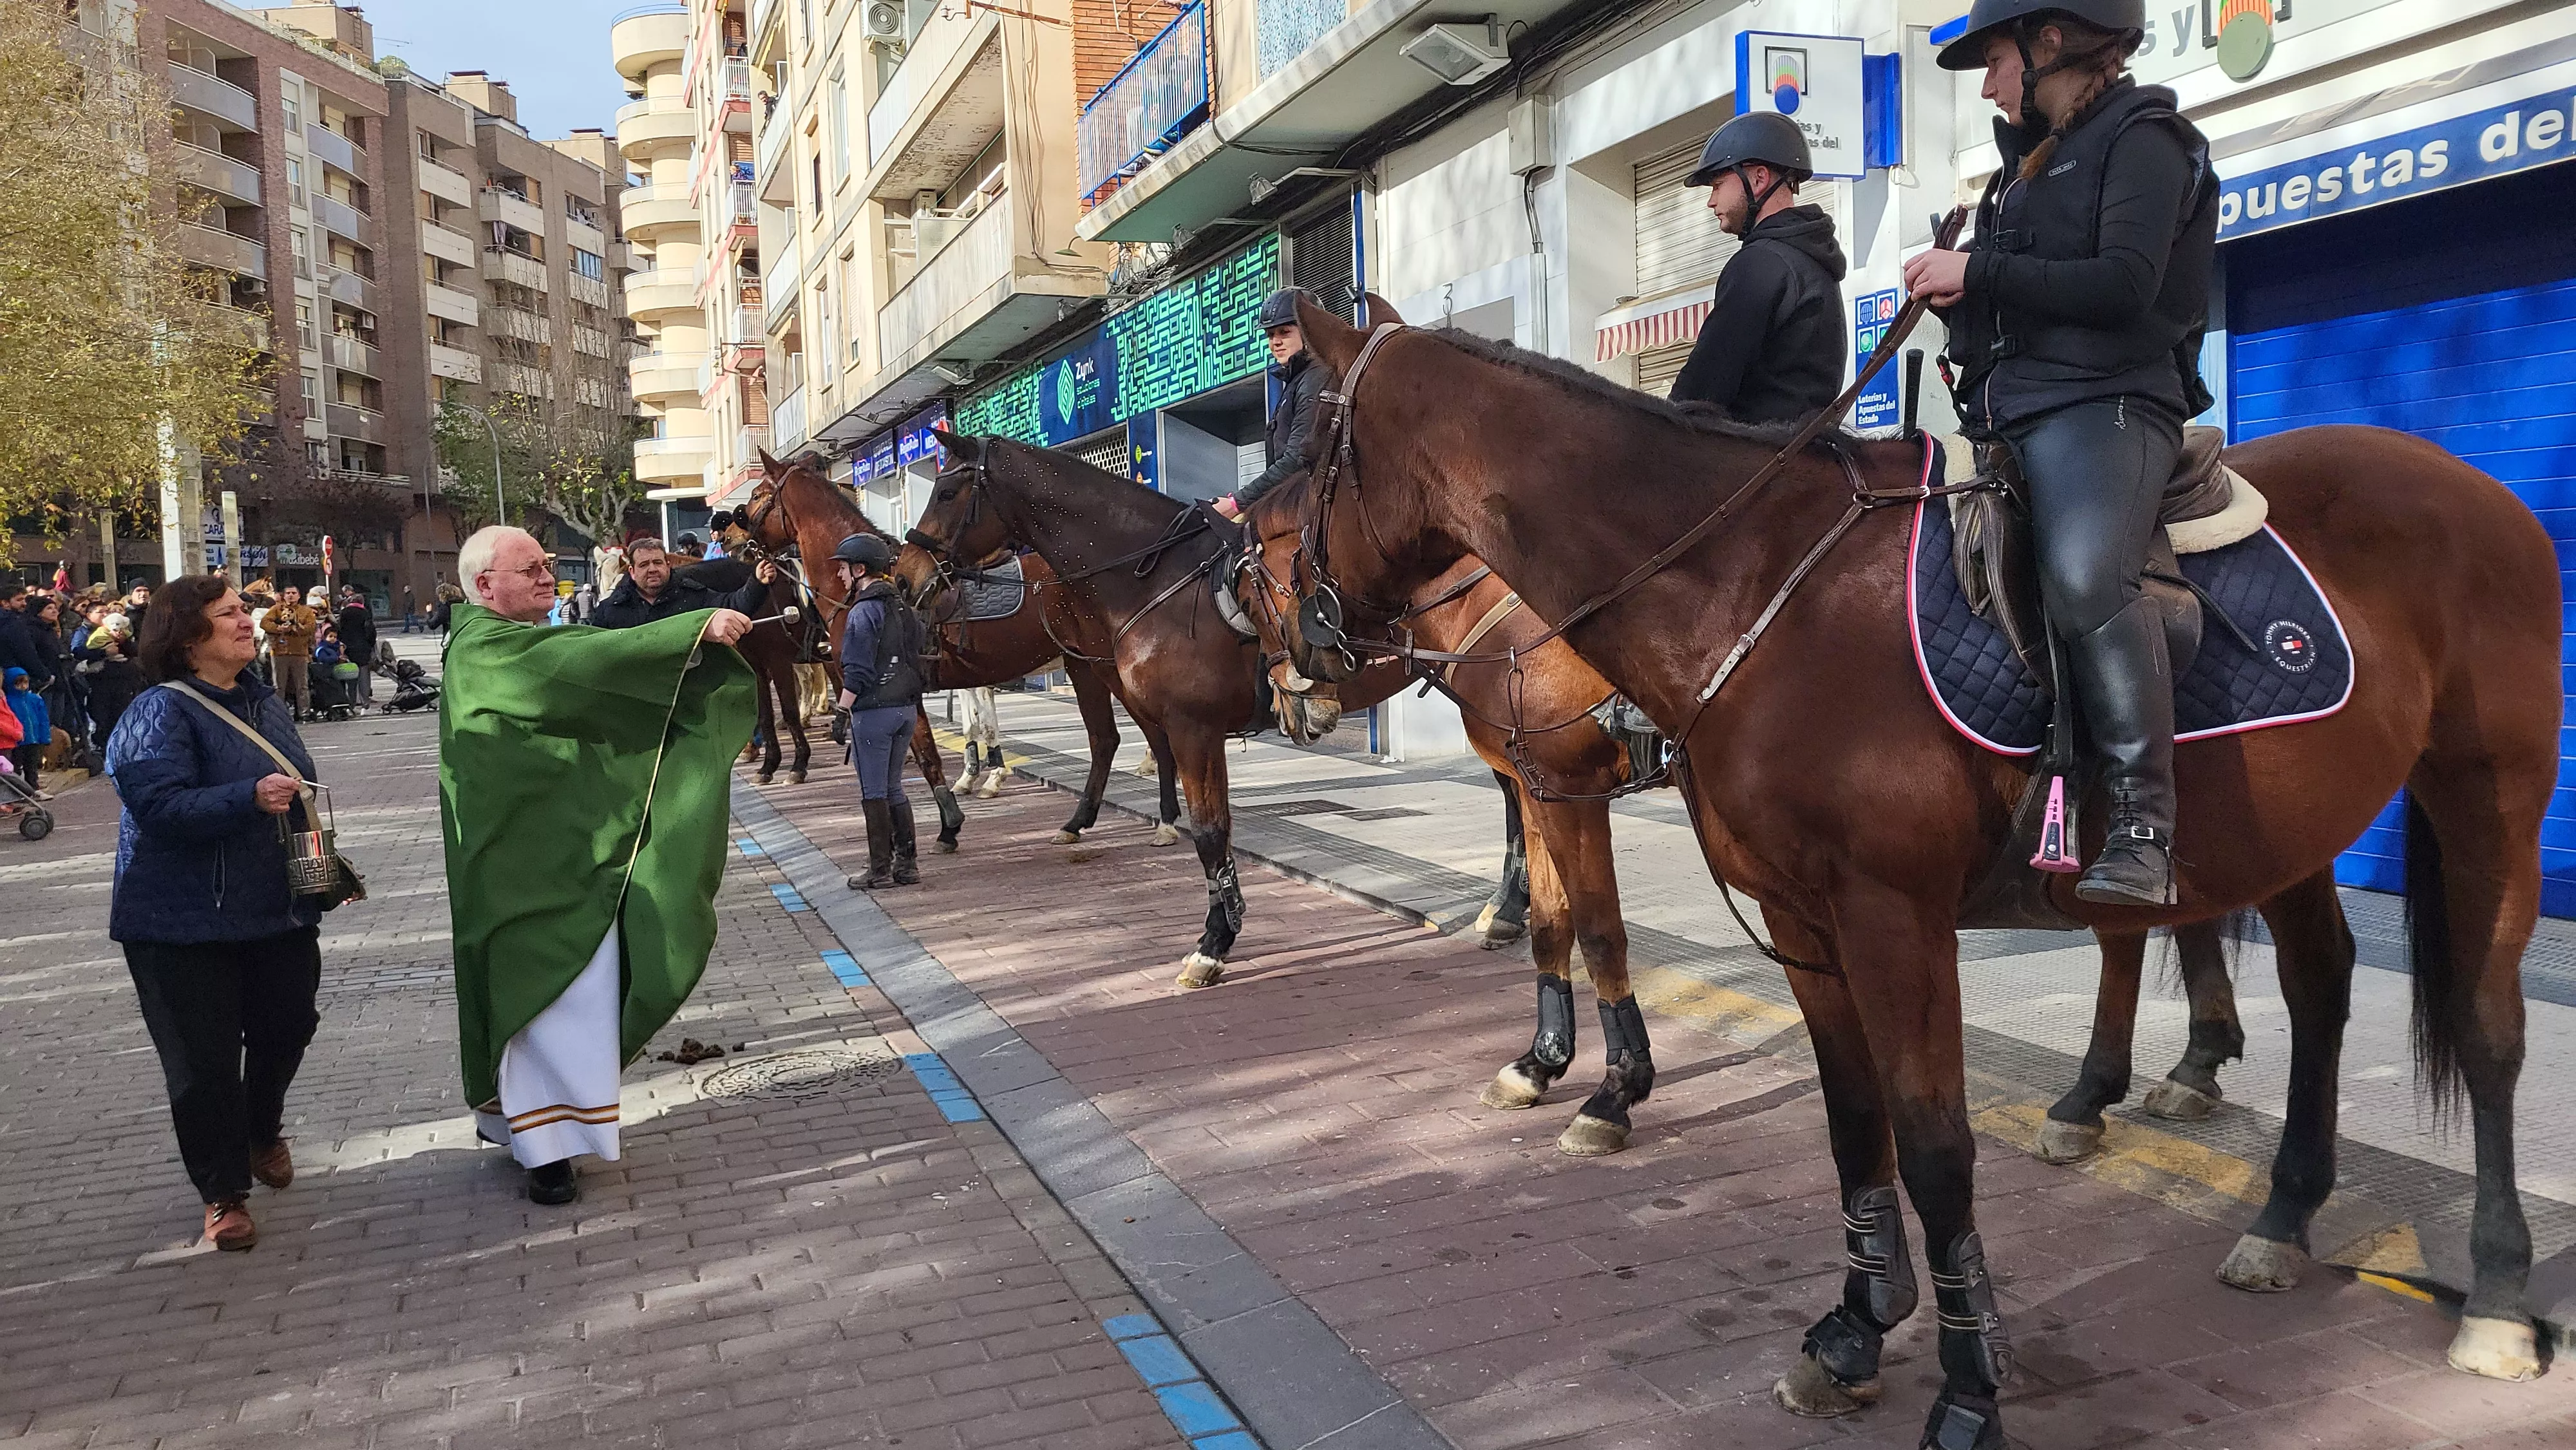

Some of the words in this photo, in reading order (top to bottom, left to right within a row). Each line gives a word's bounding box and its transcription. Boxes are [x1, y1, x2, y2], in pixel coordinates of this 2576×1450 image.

[2171, 4, 2195, 57] y
[1815, 123, 1821, 135] y
[1823, 136, 1839, 149] del
[2217, 138, 2448, 233] puestas
[2479, 95, 2576, 164] de
[1075, 356, 1095, 381] Zynk
[1857, 392, 1882, 404] Loterías
[1882, 392, 1887, 402] y
[1858, 403, 1886, 416] Apuestas
[1886, 399, 1895, 410] del
[1858, 413, 1879, 425] Estado
[2266, 623, 2278, 645] TOMMY
[2278, 621, 2311, 640] HILFIGER
[2275, 652, 2316, 672] EQUESTRIAN
